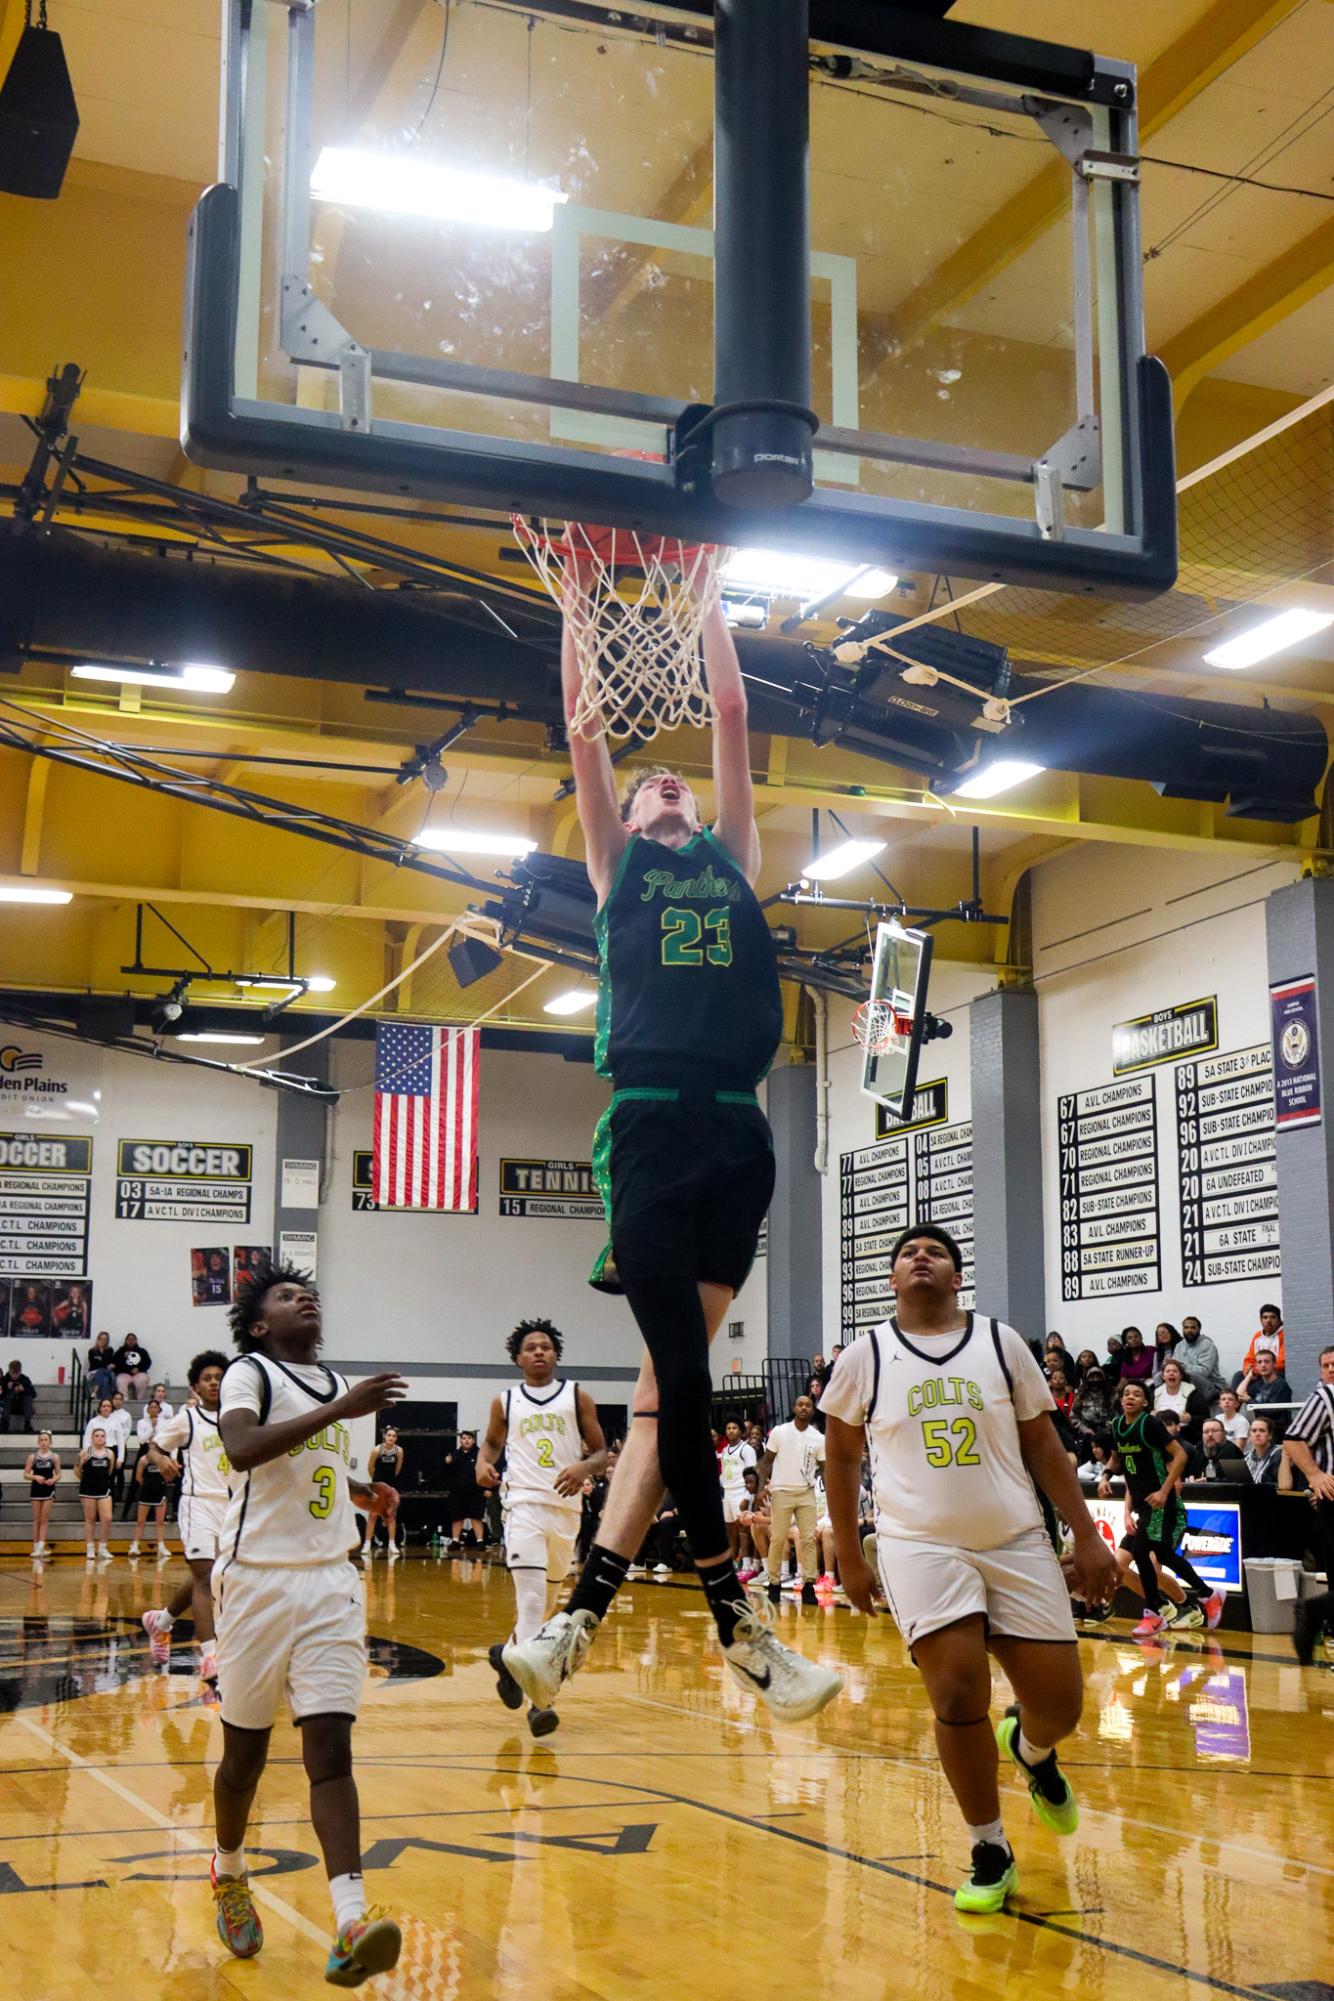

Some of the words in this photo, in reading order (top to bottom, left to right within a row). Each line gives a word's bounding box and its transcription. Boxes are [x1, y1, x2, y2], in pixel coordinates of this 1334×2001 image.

[661, 906, 733, 967] 23
[1153, 1009, 1172, 1023] BOYS
[24, 1077, 68, 1094] Plains
[1178, 1064, 1195, 1091] 89
[1204, 1066, 1215, 1079] 5A
[1217, 1059, 1238, 1075] STATE
[1292, 1072, 1317, 1084] NATIONAL
[1060, 1096, 1075, 1119] 67
[1102, 1084, 1143, 1104] CHAMPIONS
[1178, 1092, 1196, 1118] 92
[1201, 1087, 1239, 1107] SUB-STATE
[1281, 1087, 1294, 1098] BLUE
[1294, 1083, 1313, 1095] RIBBON
[1288, 1095, 1307, 1107] SCHOOL
[1060, 1121, 1075, 1145] 67
[1079, 1119, 1111, 1136] REGIONAL
[1112, 1109, 1151, 1128] CHAMPIONS
[1179, 1119, 1197, 1145] 96
[1202, 1115, 1240, 1135] SUB-STATE
[917, 1134, 929, 1155] 04
[937, 1132, 960, 1145] REGIONAL
[1061, 1147, 1076, 1171] 70
[1080, 1145, 1112, 1161] REGIONAL
[1113, 1136, 1152, 1154] CHAMPIONS
[132, 1145, 241, 1177] SOCCER
[547, 1161, 575, 1170] GIRLS
[841, 1153, 853, 1173] 77
[871, 1145, 899, 1162] CHAMPIONS
[917, 1157, 929, 1178] 05
[1181, 1147, 1199, 1173] 20
[1232, 1144, 1243, 1157] DIV
[4, 1181, 40, 1190] REGIONAL
[42, 1182, 85, 1192] CHAMPIONS
[120, 1181, 142, 1200] 03
[176, 1188, 210, 1199] REGIONAL
[212, 1189, 243, 1200] CHAMPS
[842, 1175, 853, 1195] 77
[855, 1173, 877, 1186] REGIONAL
[877, 1167, 905, 1182] CHAMPIONS
[917, 1180, 930, 1200] 08
[1062, 1173, 1076, 1196] 71
[1081, 1171, 1112, 1187] REGIONAL
[1114, 1163, 1152, 1181] CHAMPIONS
[1182, 1175, 1199, 1201] 20
[1206, 1178, 1216, 1191] 6A
[1218, 1169, 1264, 1188] UNDEFEATED
[9, 1201, 42, 1211] REGIONAL
[44, 1202, 83, 1212] CHAMPIONS
[119, 1201, 141, 1219] 17
[182, 1207, 194, 1216] DIV
[200, 1208, 243, 1219] CHAMPIONS
[356, 1192, 376, 1211] 73
[503, 1199, 521, 1216] 15
[530, 1203, 566, 1215] REGIONAL
[842, 1197, 853, 1216] 81
[872, 1190, 900, 1206] CHAMPIONS
[918, 1203, 930, 1223] 11
[939, 1202, 961, 1214] REGIONAL
[1063, 1198, 1077, 1222] 82
[1082, 1197, 1114, 1214] SUB-STATE
[1115, 1190, 1152, 1208] CHAMPIONS
[28, 1221, 77, 1232] CHAMPIONS
[842, 1218, 853, 1237] 89
[872, 1213, 900, 1228] CHAMPIONS
[1183, 1204, 1199, 1228] 21
[1233, 1201, 1245, 1215] DIV
[1063, 1224, 1078, 1248] 83
[1105, 1218, 1146, 1235] CHAMPIONS
[1184, 1232, 1200, 1257] 21
[1219, 1234, 1230, 1246] 6A
[1233, 1229, 1256, 1245] STATE
[26, 1241, 77, 1252] CHAMPIONS
[842, 1241, 853, 1259] 91
[863, 1242, 877, 1252] STATE
[26, 1261, 76, 1272] CHAMPIONS
[842, 1262, 853, 1281] 93
[856, 1264, 878, 1274] REGIONAL
[1064, 1250, 1079, 1274] 88
[1083, 1253, 1092, 1265] 5A
[1093, 1250, 1114, 1264] STATE
[1116, 1245, 1154, 1261] RUNNER-UP
[1184, 1260, 1202, 1285] 24
[1207, 1260, 1246, 1276] SUB-STATE
[842, 1284, 853, 1303] 96
[856, 1286, 879, 1296] REGIONAL
[1064, 1276, 1079, 1299] 89
[1107, 1273, 1148, 1289] CHAMPIONS
[842, 1306, 853, 1325] 99
[862, 1306, 881, 1317] REGIONAL
[907, 1377, 984, 1417] COLTS
[519, 1412, 566, 1438] COLTS
[536, 1438, 556, 1468] 2
[921, 1417, 981, 1468] 52
[216, 1453, 231, 1477] 4
[1125, 1454, 1137, 1475] 4
[308, 1465, 337, 1520] 3
